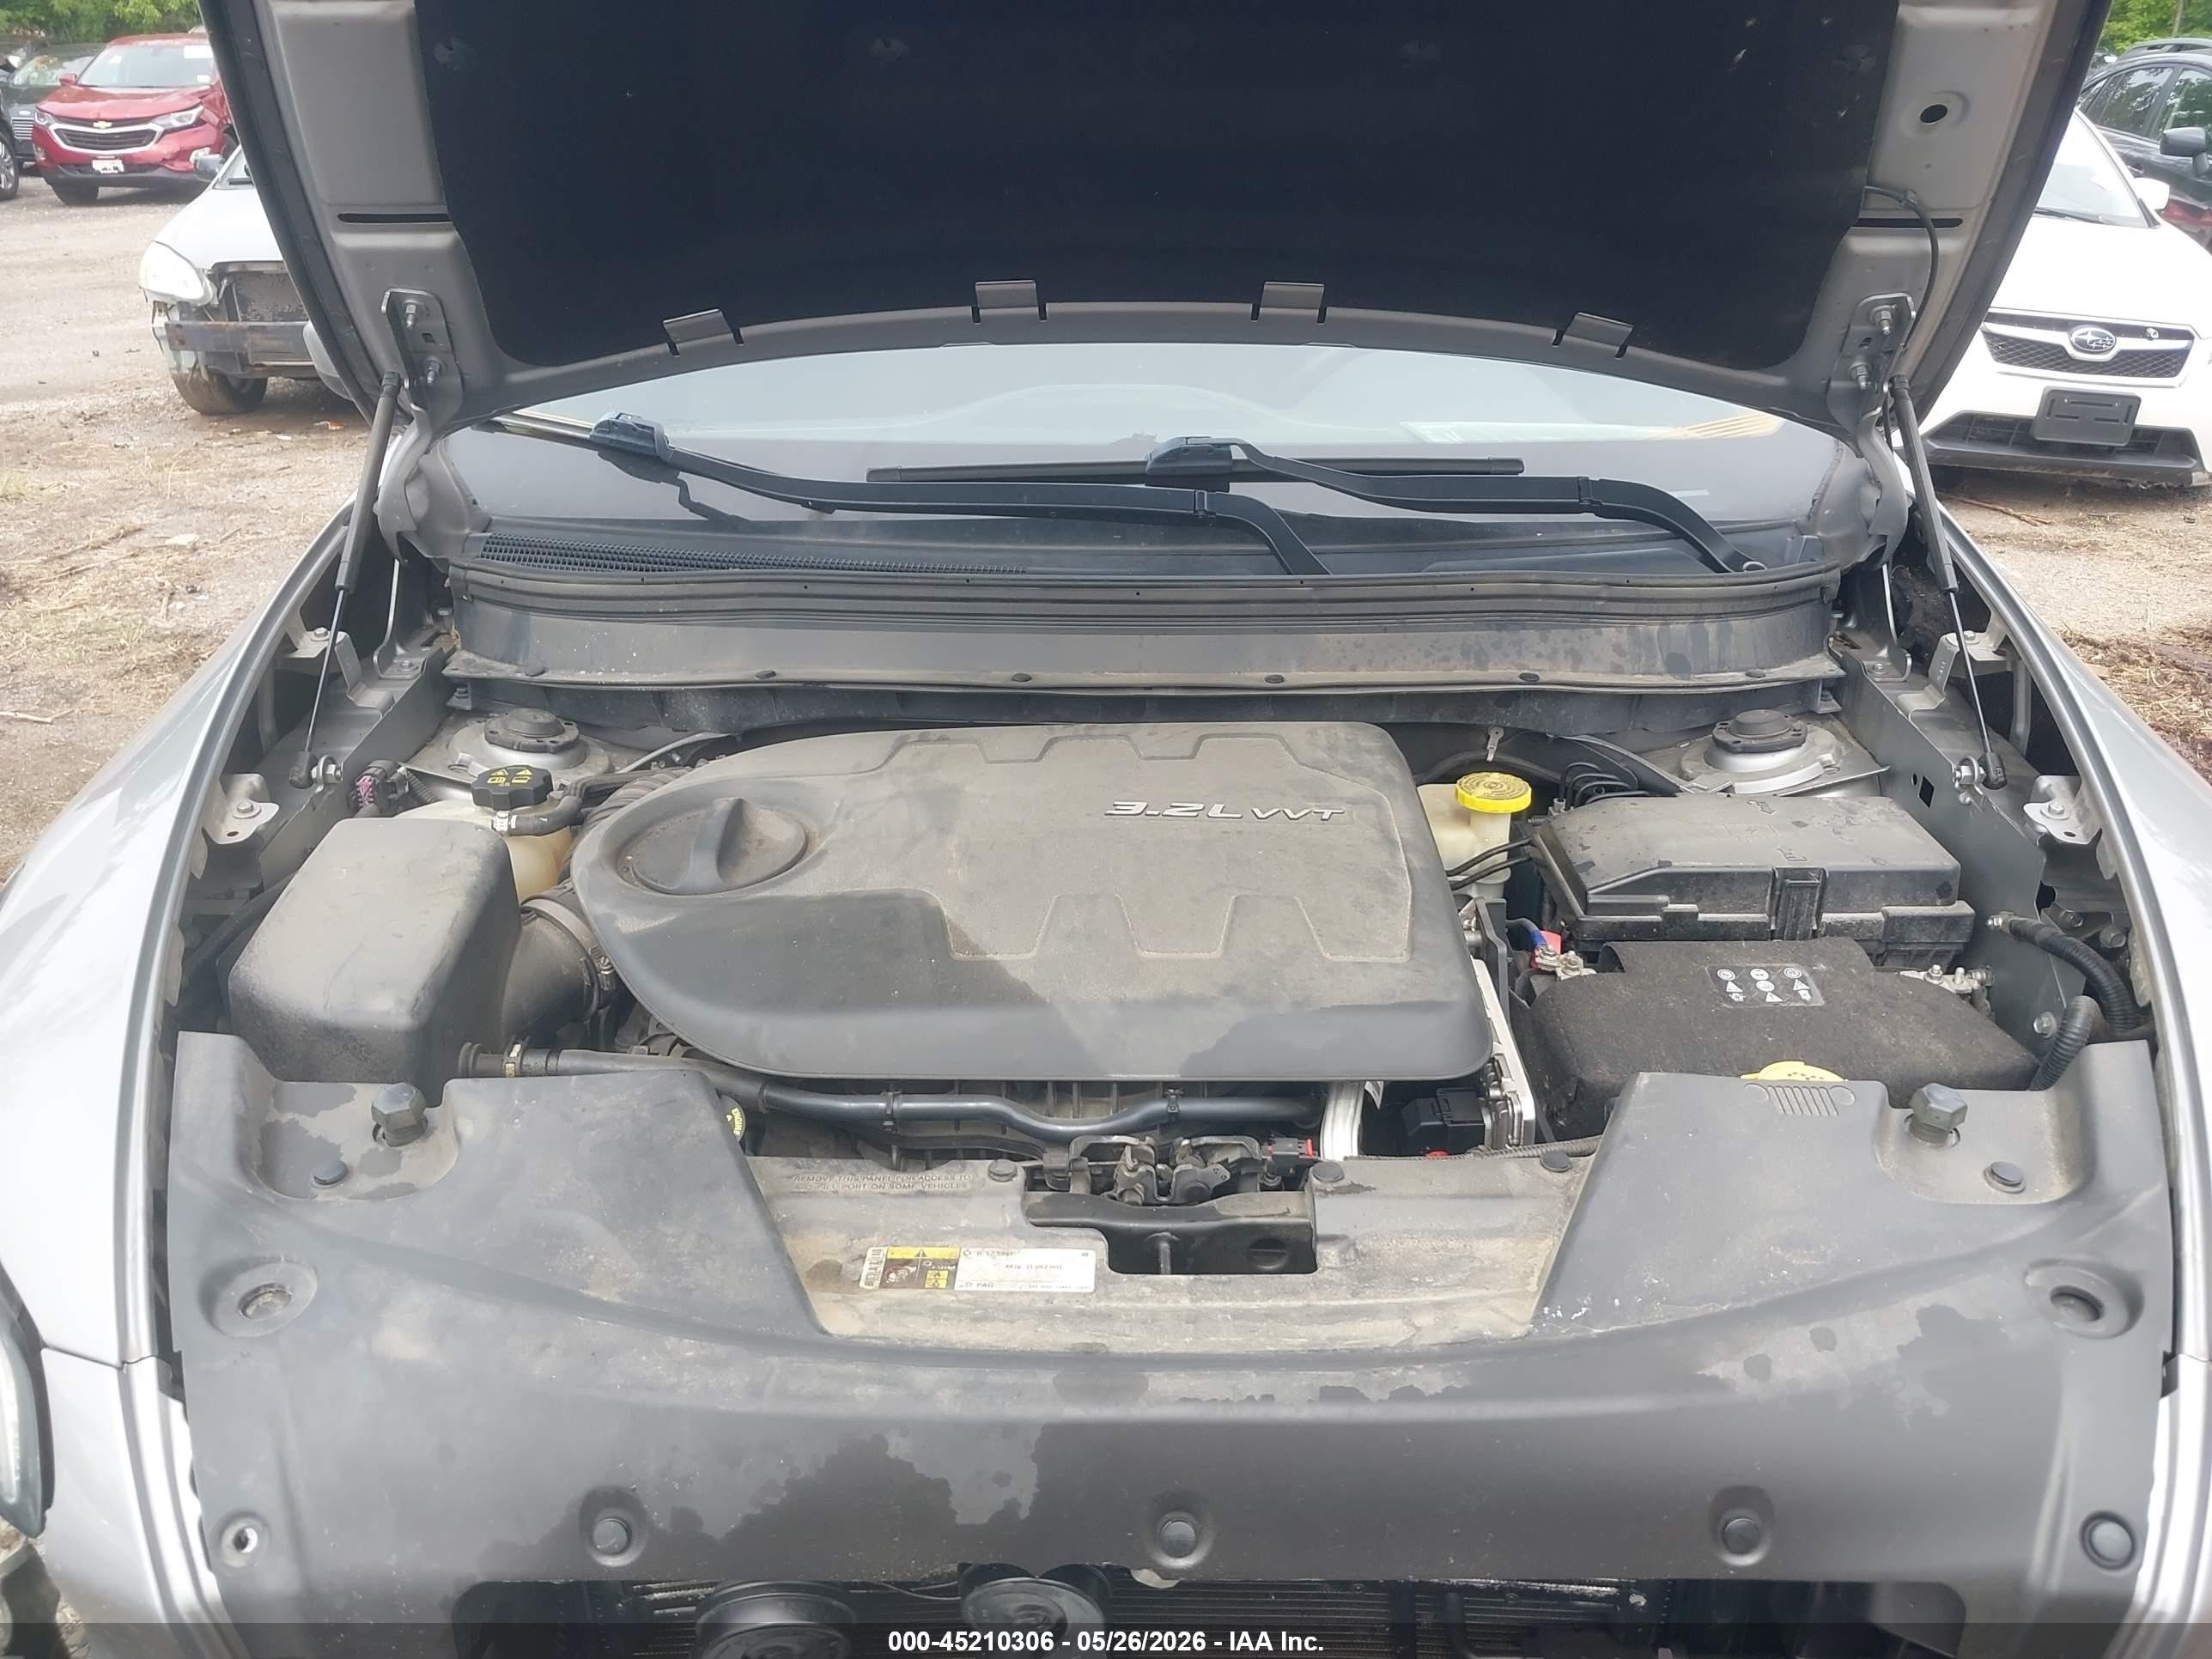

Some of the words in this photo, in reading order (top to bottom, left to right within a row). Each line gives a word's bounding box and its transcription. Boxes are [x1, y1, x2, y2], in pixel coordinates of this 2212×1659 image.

[1104, 800, 1243, 818] 3.2L
[1251, 806, 1345, 822] VVT
[793, 1174, 832, 1182] REMOVE
[862, 1174, 892, 1182] PANEL
